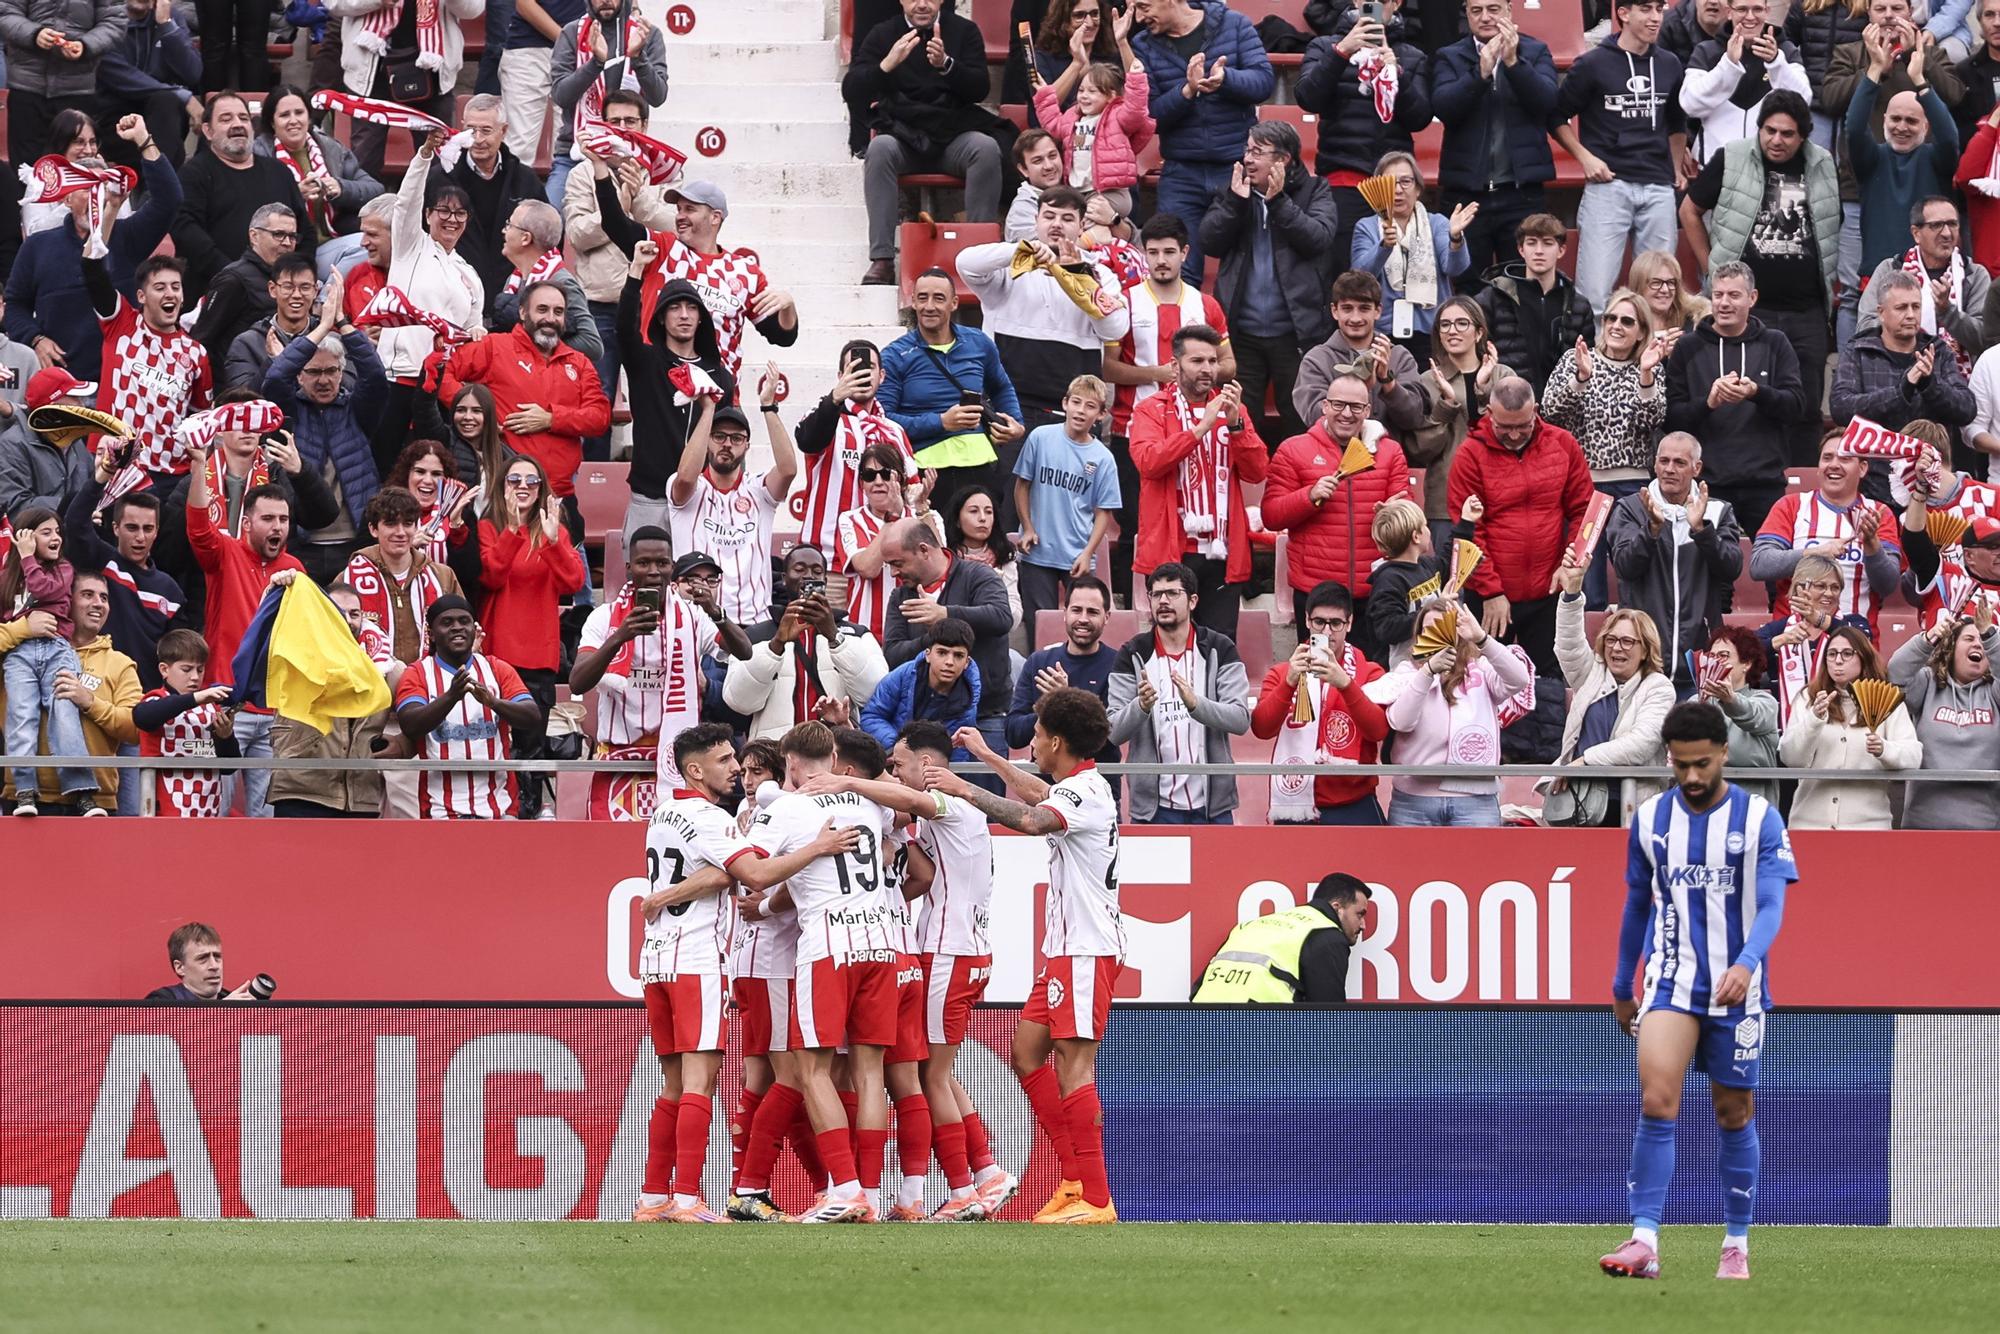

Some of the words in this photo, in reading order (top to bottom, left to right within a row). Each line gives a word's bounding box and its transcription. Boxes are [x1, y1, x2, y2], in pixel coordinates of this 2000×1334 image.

[701, 131, 720, 149] 10
[692, 282, 741, 308] TIHAD
[132, 362, 189, 392] ETIHAD
[1040, 466, 1092, 496] URUGUAY
[703, 519, 756, 538] ETIHAD
[712, 539, 746, 556] AIRWAYS
[1936, 707, 1975, 725] GIRONA
[1976, 709, 1991, 724] FC
[829, 825, 879, 895] 19
[829, 910, 882, 927] Marlex
[1208, 967, 1251, 985] S-011
[0, 1031, 745, 1220] ALIGA
